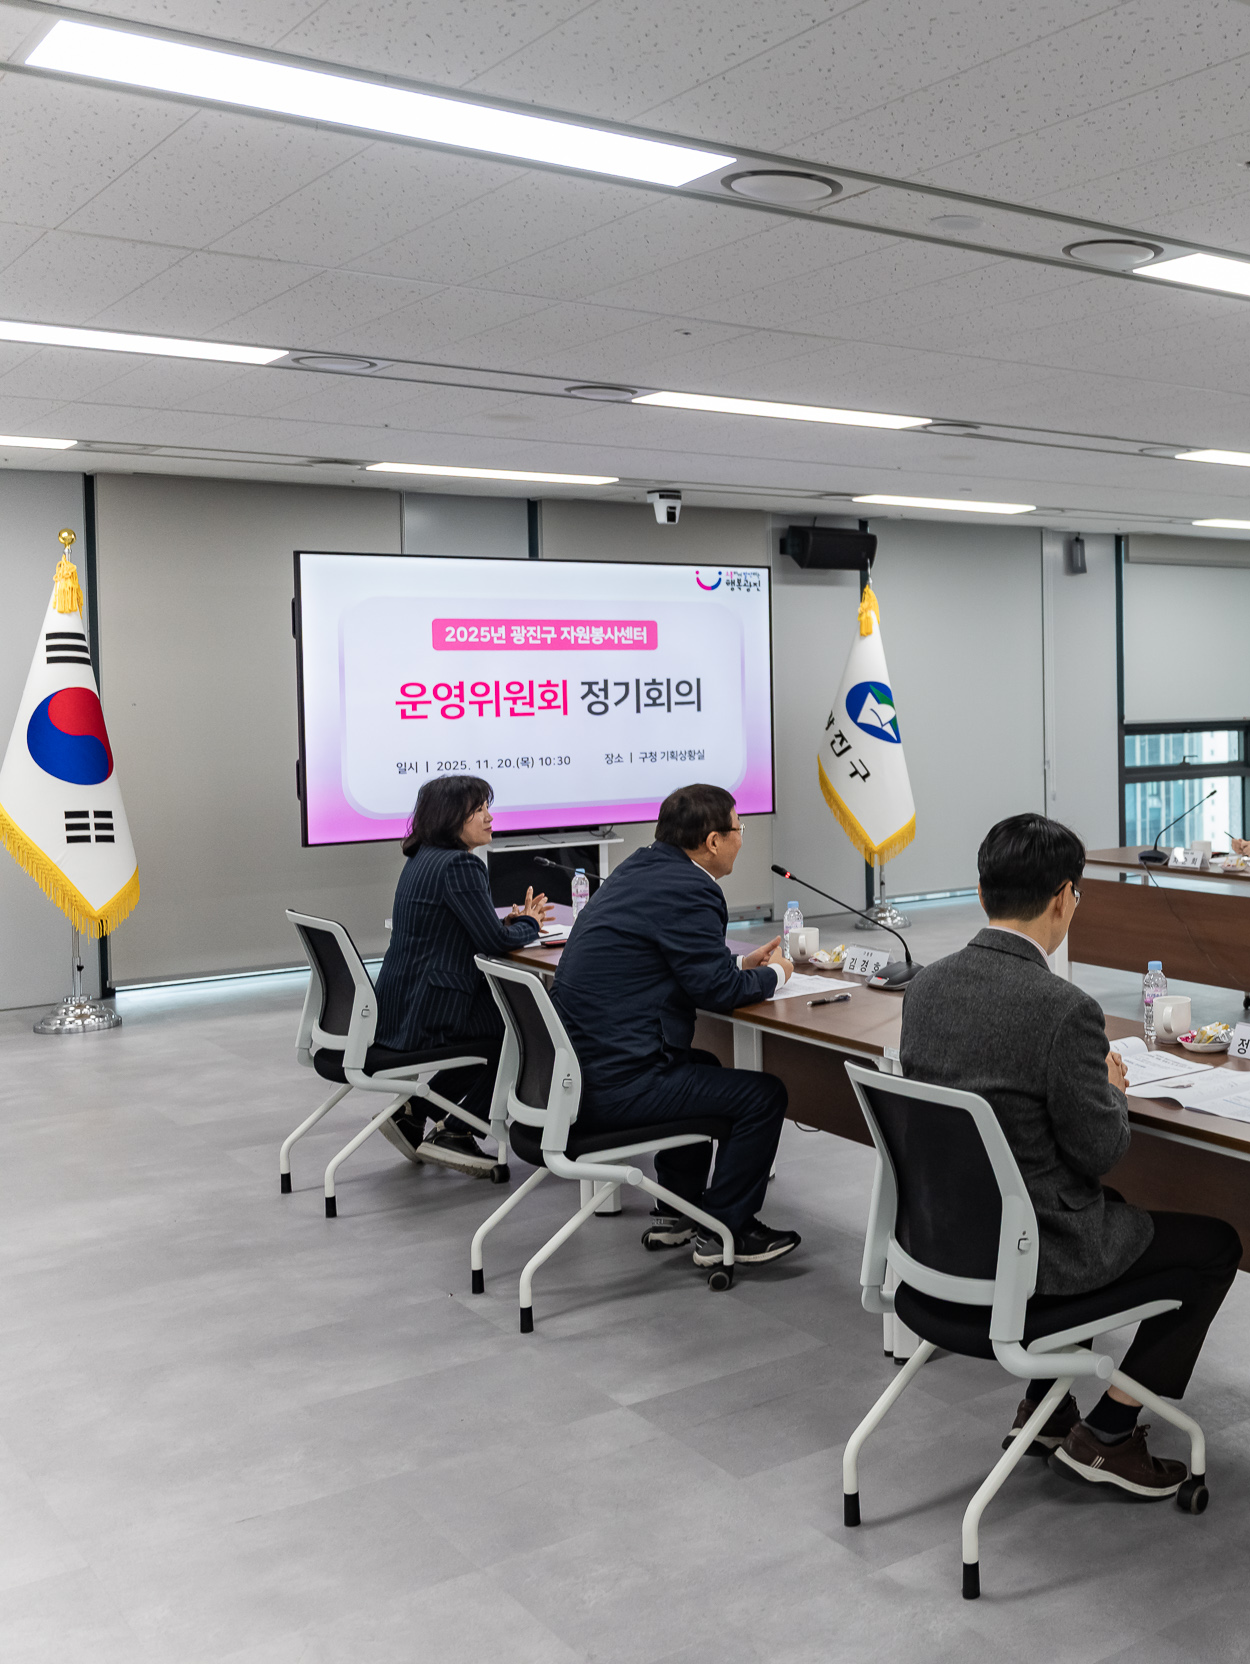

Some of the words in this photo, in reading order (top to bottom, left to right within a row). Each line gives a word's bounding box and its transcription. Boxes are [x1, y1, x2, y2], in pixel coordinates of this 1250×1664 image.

[445, 625, 506, 644] 2025년
[510, 625, 557, 644] 광진구
[560, 626, 647, 644] 자원봉사센터
[395, 679, 569, 720] 운영위원회
[579, 677, 703, 716] 정기회의
[396, 761, 418, 774] 일시
[437, 760, 471, 772] 2025.
[475, 759, 493, 770] 11.
[497, 756, 535, 769] 20.(목)
[539, 755, 571, 767] 10:30
[604, 752, 624, 765] 장소
[638, 751, 658, 763] 구청
[660, 749, 706, 762] 기획상황실
